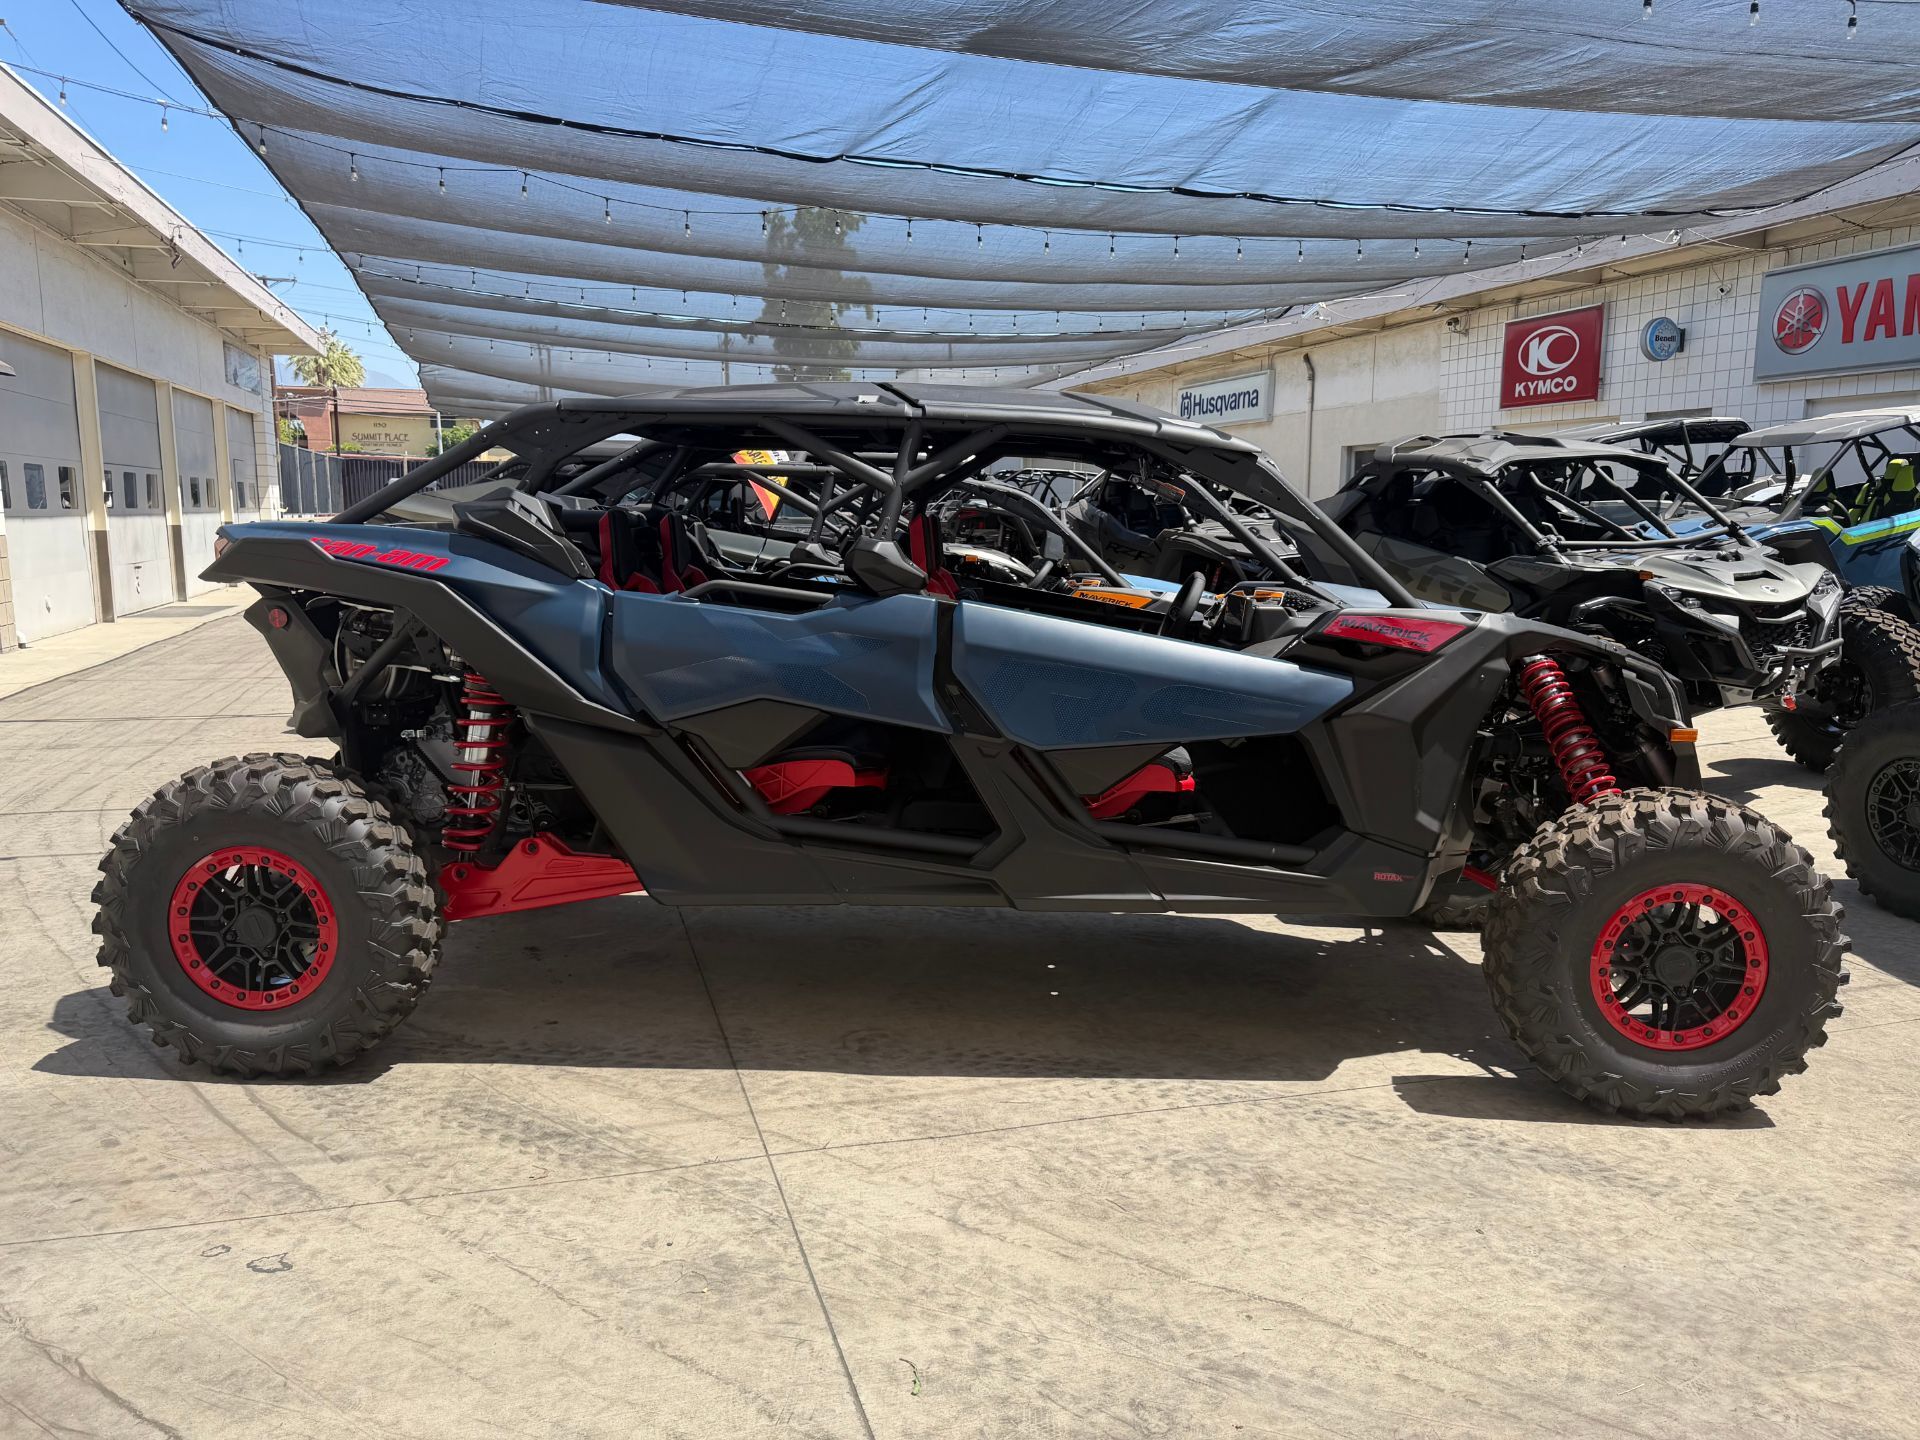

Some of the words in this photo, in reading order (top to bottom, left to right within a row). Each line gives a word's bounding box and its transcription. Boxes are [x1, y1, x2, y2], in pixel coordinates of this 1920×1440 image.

[1654, 334, 1678, 343] Benelli
[1514, 375, 1578, 397] KYMCO
[1192, 388, 1259, 416] Husqvarna
[351, 432, 382, 441] SUMMIT
[384, 433, 411, 442] PLACE
[1078, 591, 1134, 608] MAVERICK
[1339, 616, 1432, 643] MAVERICK
[1374, 871, 1403, 882] ROTAX
